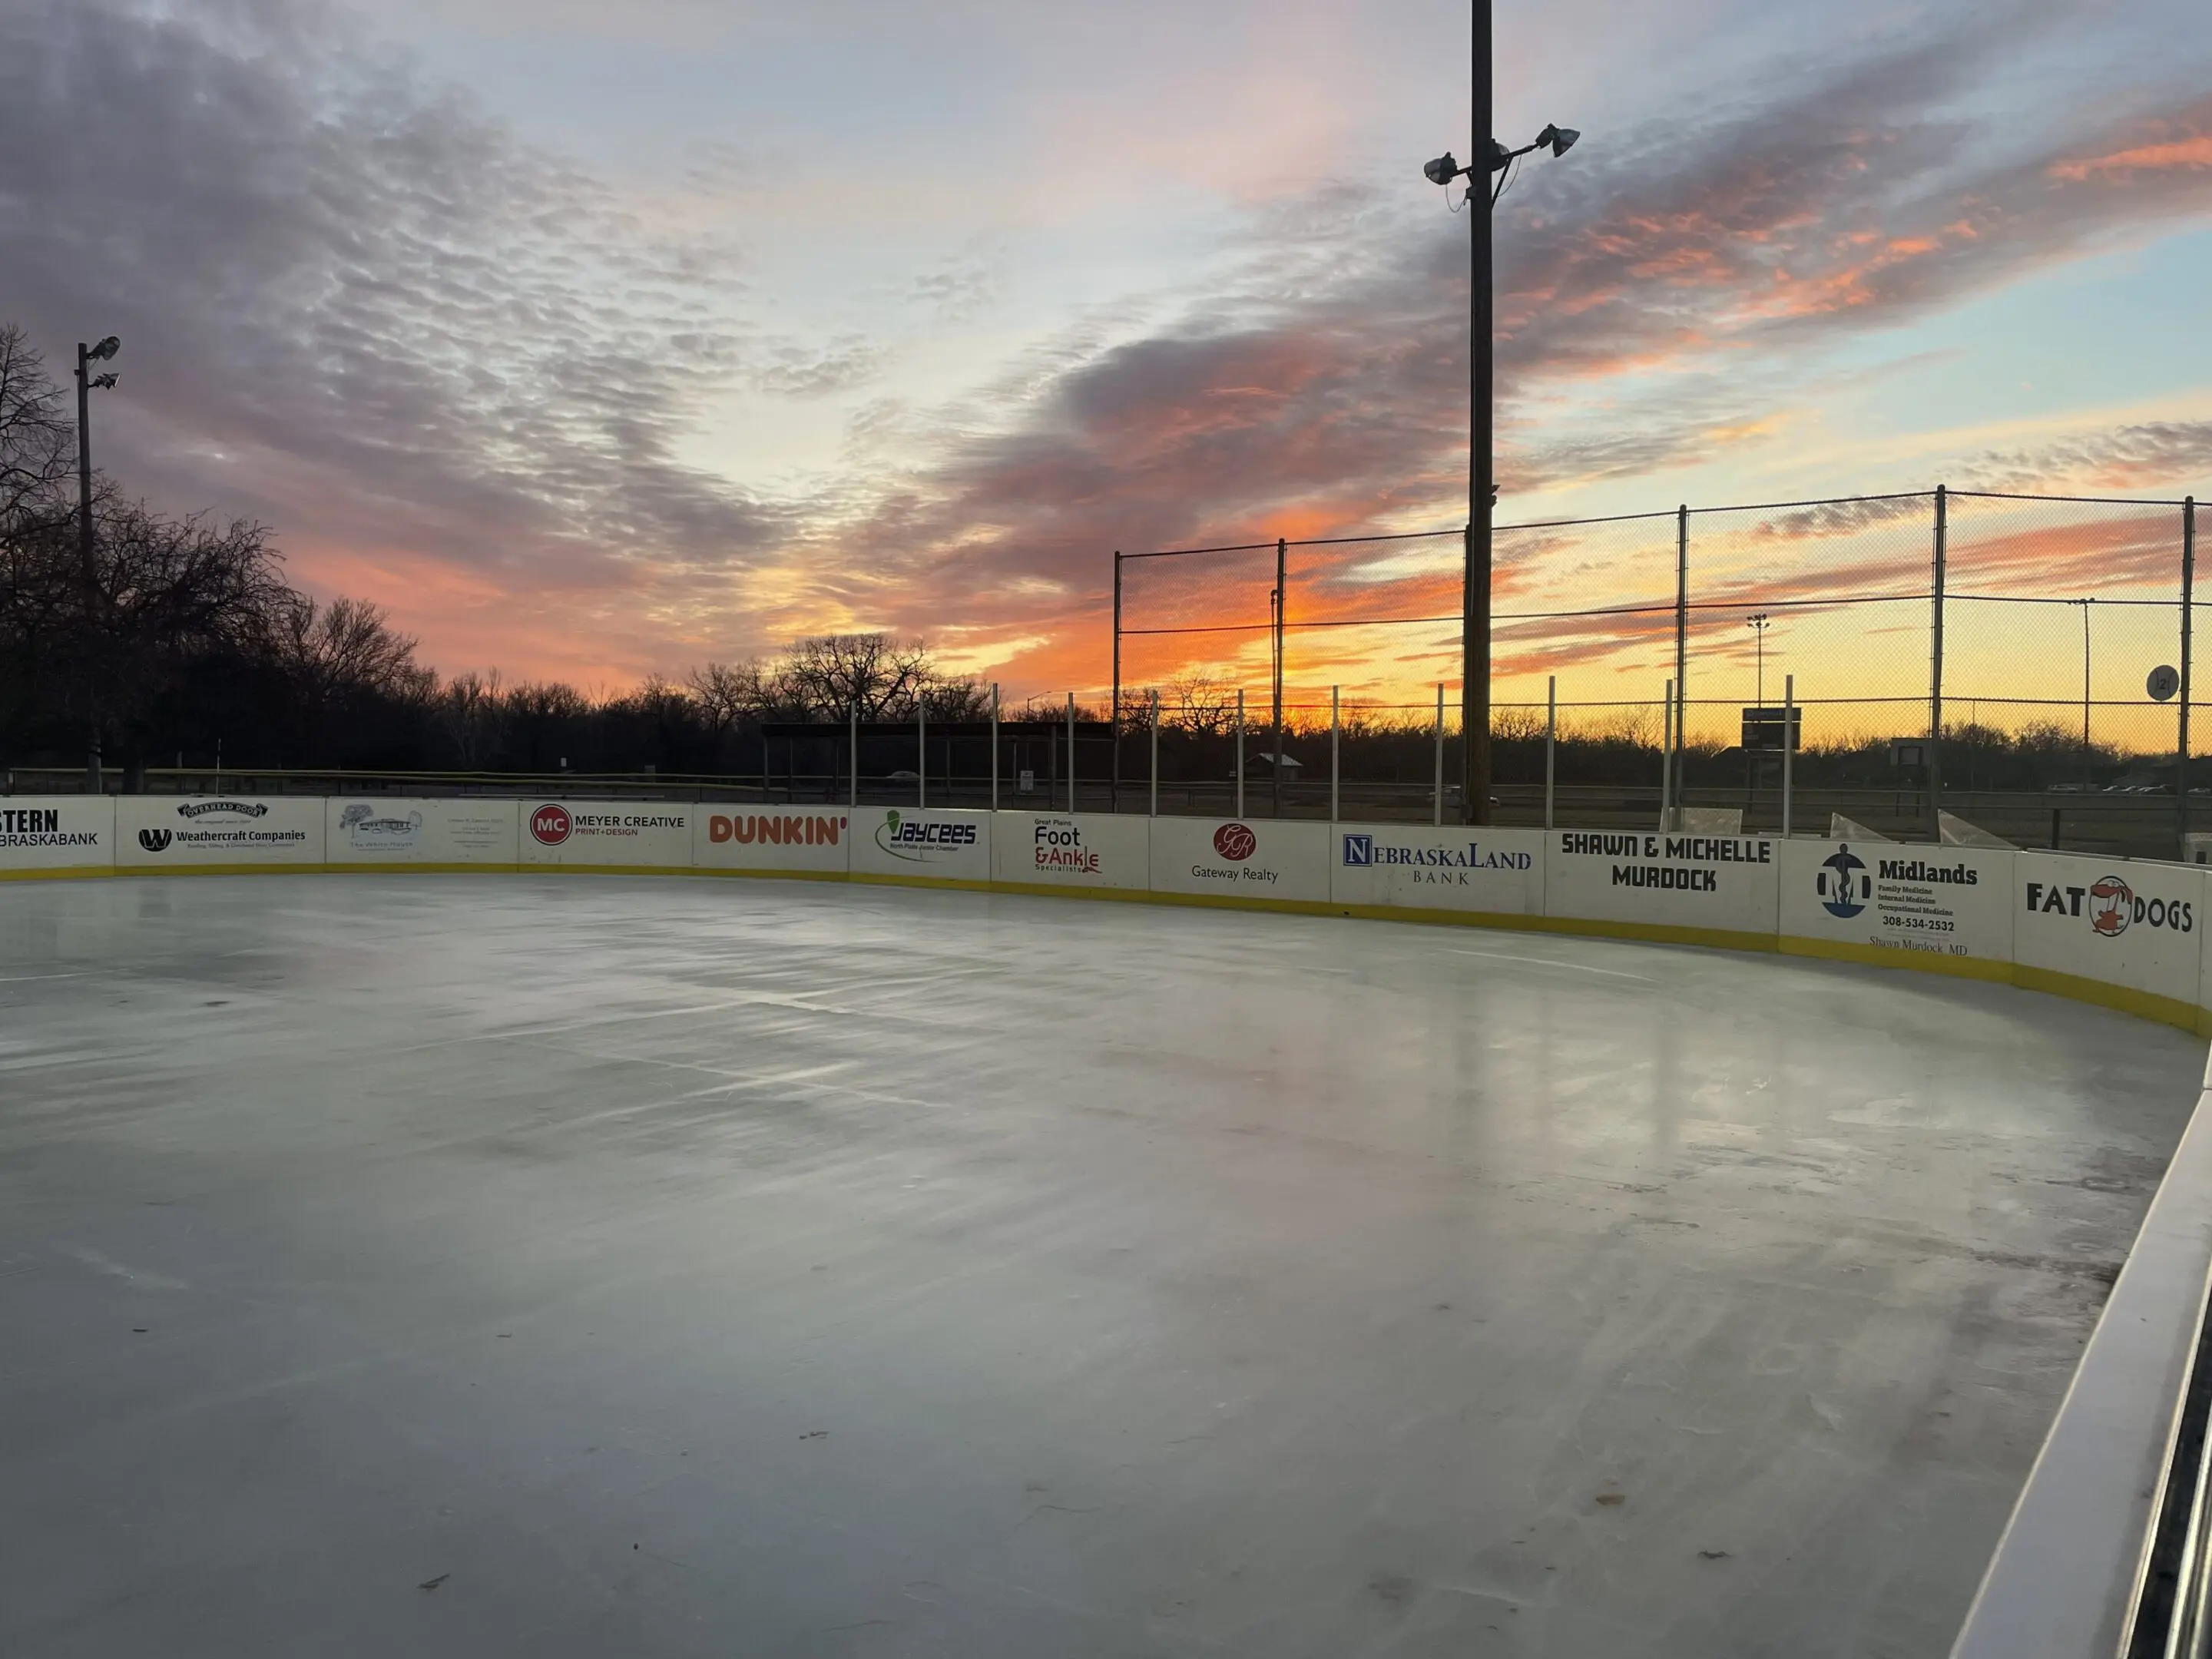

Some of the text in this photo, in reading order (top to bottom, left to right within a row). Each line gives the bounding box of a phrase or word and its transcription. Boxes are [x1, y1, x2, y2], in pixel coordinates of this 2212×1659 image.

[2159, 678, 2167, 690] 2
[187, 803, 258, 816] OVERHEAD DOOR
[0, 810, 58, 833] TERN
[538, 817, 566, 833] MC
[576, 816, 684, 828] MEYER CREATIVE
[177, 830, 306, 843] Weathercraft Companies
[576, 828, 638, 836] PRINT+DESIGN
[710, 815, 848, 846] DUNKIN'
[1035, 826, 1081, 846] Foot
[1644, 836, 1659, 858] &
[1666, 837, 1770, 863] MICHELLE
[1035, 863, 1081, 873] Specialists
[1192, 865, 1279, 884] Gateway Realty
[1879, 859, 1978, 885] Midlands
[1413, 870, 1469, 886] BANK
[1612, 865, 1717, 892] MURDOCK
[1878, 885, 1932, 895] Family Medicine
[1878, 894, 1936, 905] Internal Medicine
[2027, 882, 2193, 932] FAT DOGS
[1878, 903, 1953, 916] Occupational Medicine
[1883, 916, 1955, 932] 308-534-2532
[1869, 935, 1899, 949] Shawn
[1902, 939, 1943, 953] Murdock
[1949, 944, 1968, 956] MD
